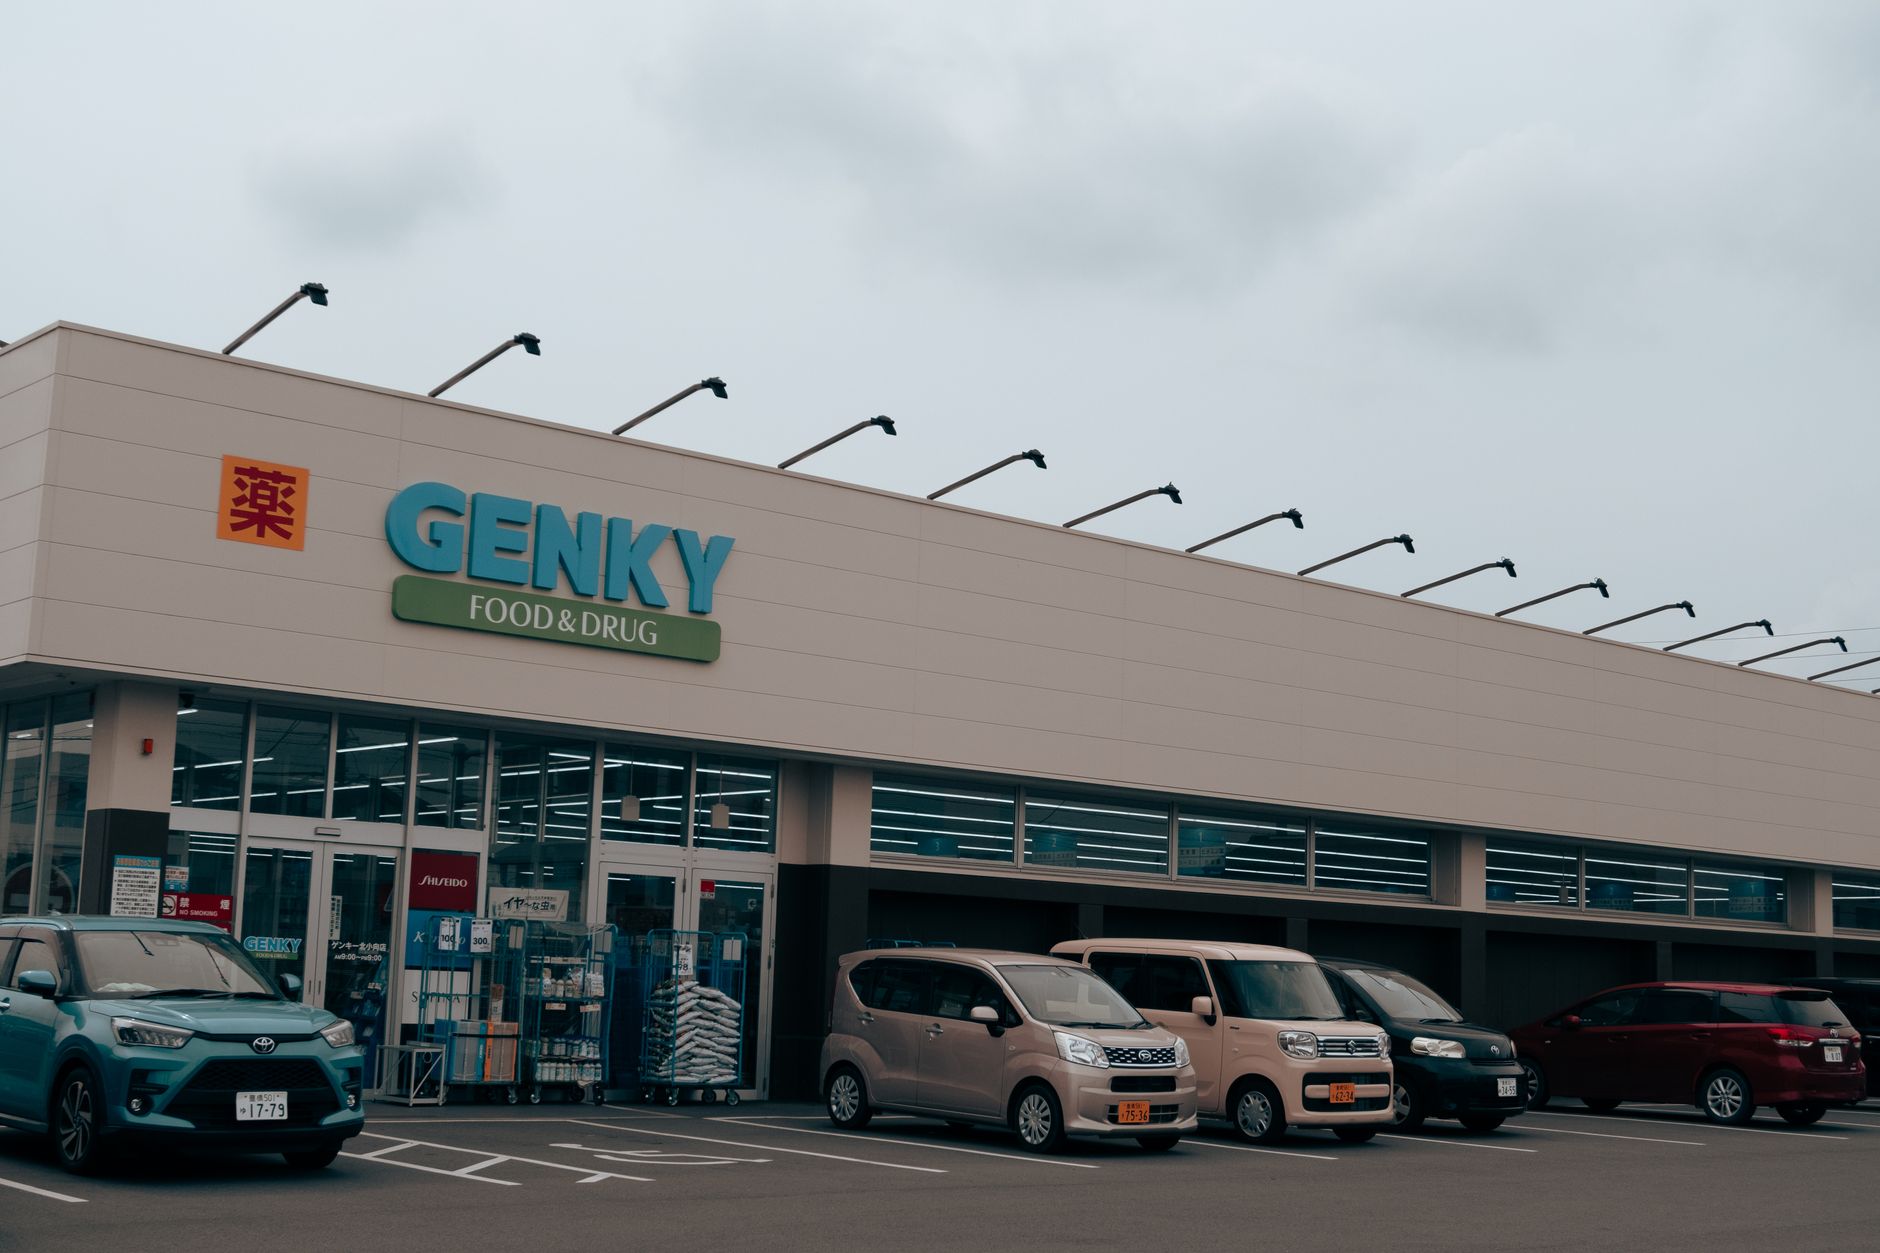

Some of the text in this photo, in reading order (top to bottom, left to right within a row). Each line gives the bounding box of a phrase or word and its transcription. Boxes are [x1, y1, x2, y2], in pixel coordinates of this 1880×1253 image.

[229, 466, 297, 540] 薬
[385, 482, 735, 614] GENKY
[418, 875, 468, 888] SHISEIDO
[243, 935, 302, 953] GENKY
[473, 937, 488, 945] 300
[250, 1103, 285, 1118] 17-79
[1125, 1110, 1148, 1121] 75-36
